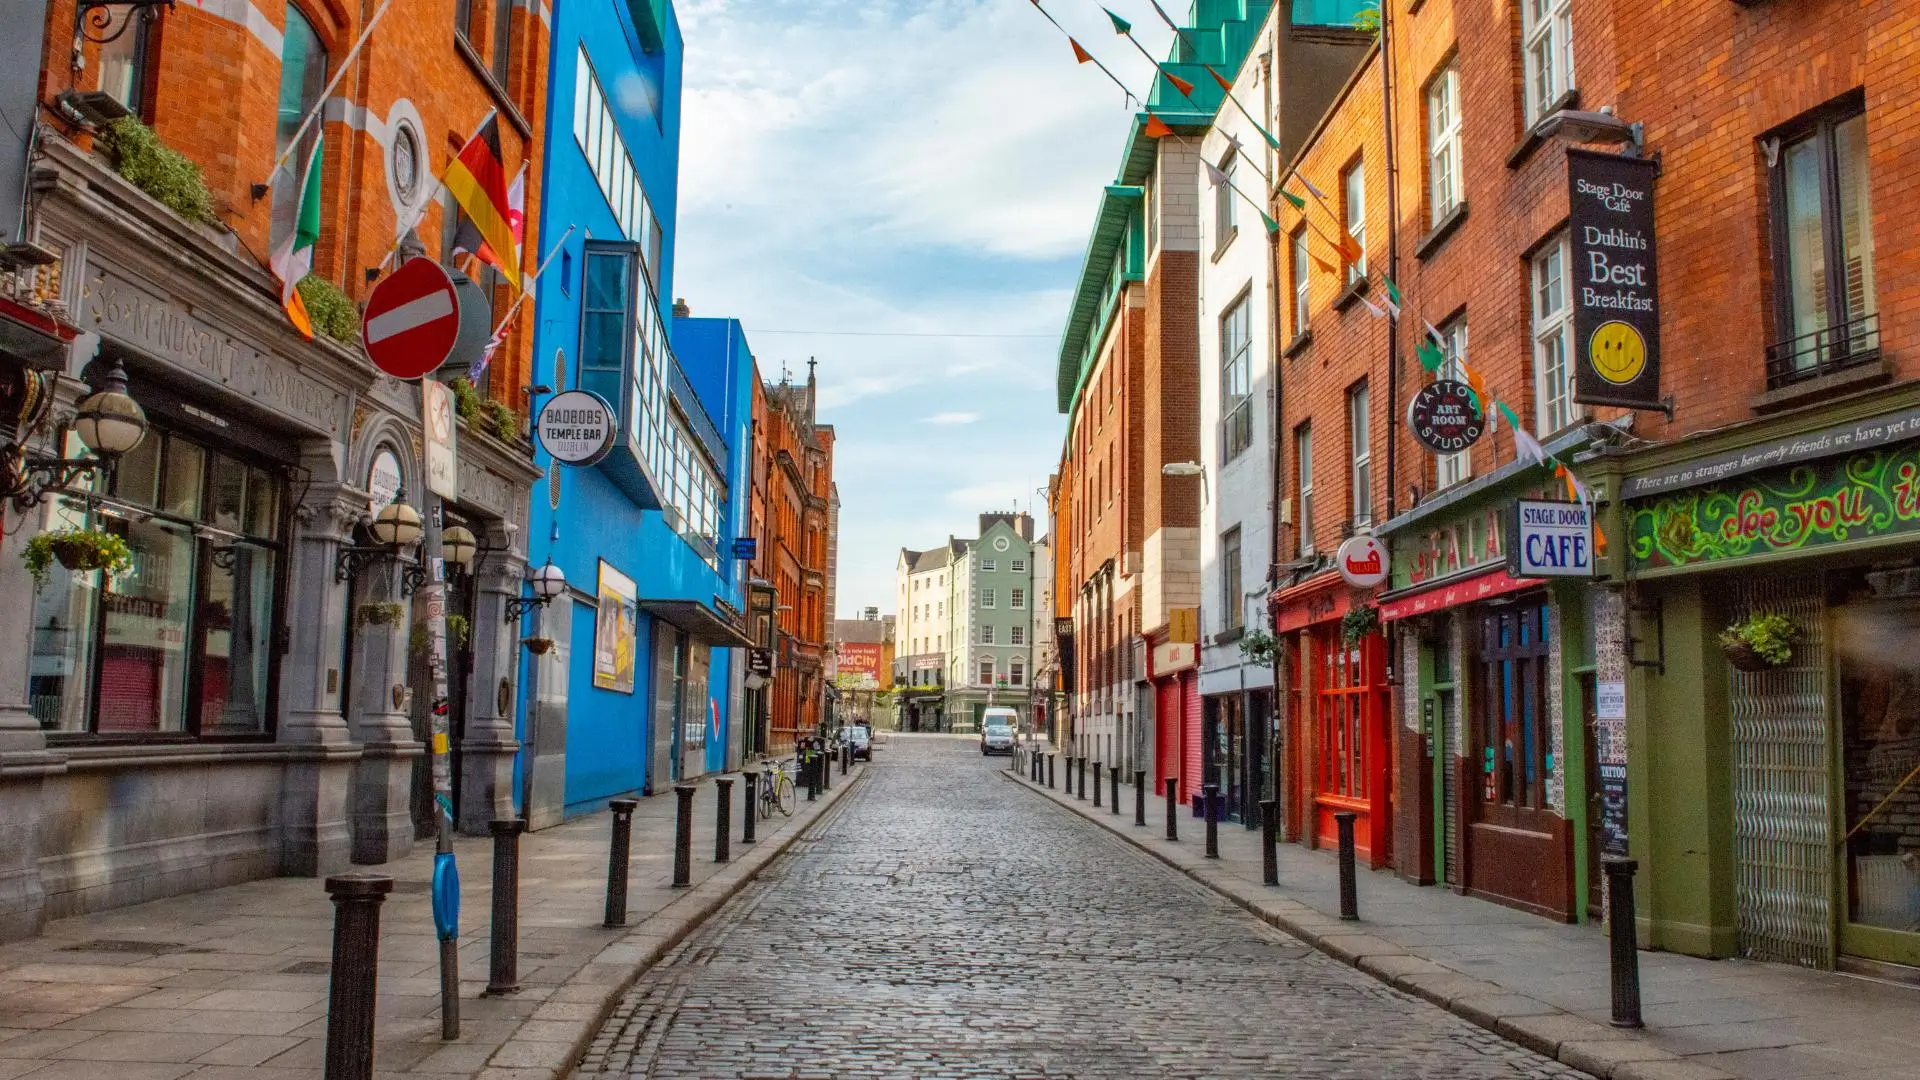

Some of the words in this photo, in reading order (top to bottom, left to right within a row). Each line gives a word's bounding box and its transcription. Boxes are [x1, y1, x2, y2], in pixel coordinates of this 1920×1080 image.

[1577, 179, 1610, 199] Stage
[1612, 183, 1644, 200] Door
[1604, 197, 1631, 212] Café
[1584, 226, 1647, 249] Dublin's
[1587, 251, 1647, 286] Best
[1582, 287, 1653, 311] Breakfast
[546, 408, 602, 425] BADBOBS
[1437, 405, 1461, 414] ART
[1431, 416, 1467, 425] ROOM
[546, 428, 582, 440] TEMPLE
[584, 428, 601, 440] BAR
[1422, 426, 1478, 449] STUDIO
[558, 441, 589, 453] DUBLIN
[1635, 477, 1661, 490] There
[1664, 475, 1678, 486] are
[1681, 471, 1693, 482] no
[1695, 460, 1738, 478] strangers
[1740, 453, 1762, 467] here
[1764, 445, 1788, 461] only
[1788, 435, 1830, 456] friends
[1835, 434, 1852, 445] we
[1855, 426, 1882, 441] have
[1885, 420, 1904, 440] yet
[1523, 509, 1555, 524] STAGE
[1558, 510, 1587, 525] DOOR
[1768, 486, 1872, 549] you
[1525, 532, 1588, 568] CAFÉ
[1601, 766, 1626, 778] TATTOO
